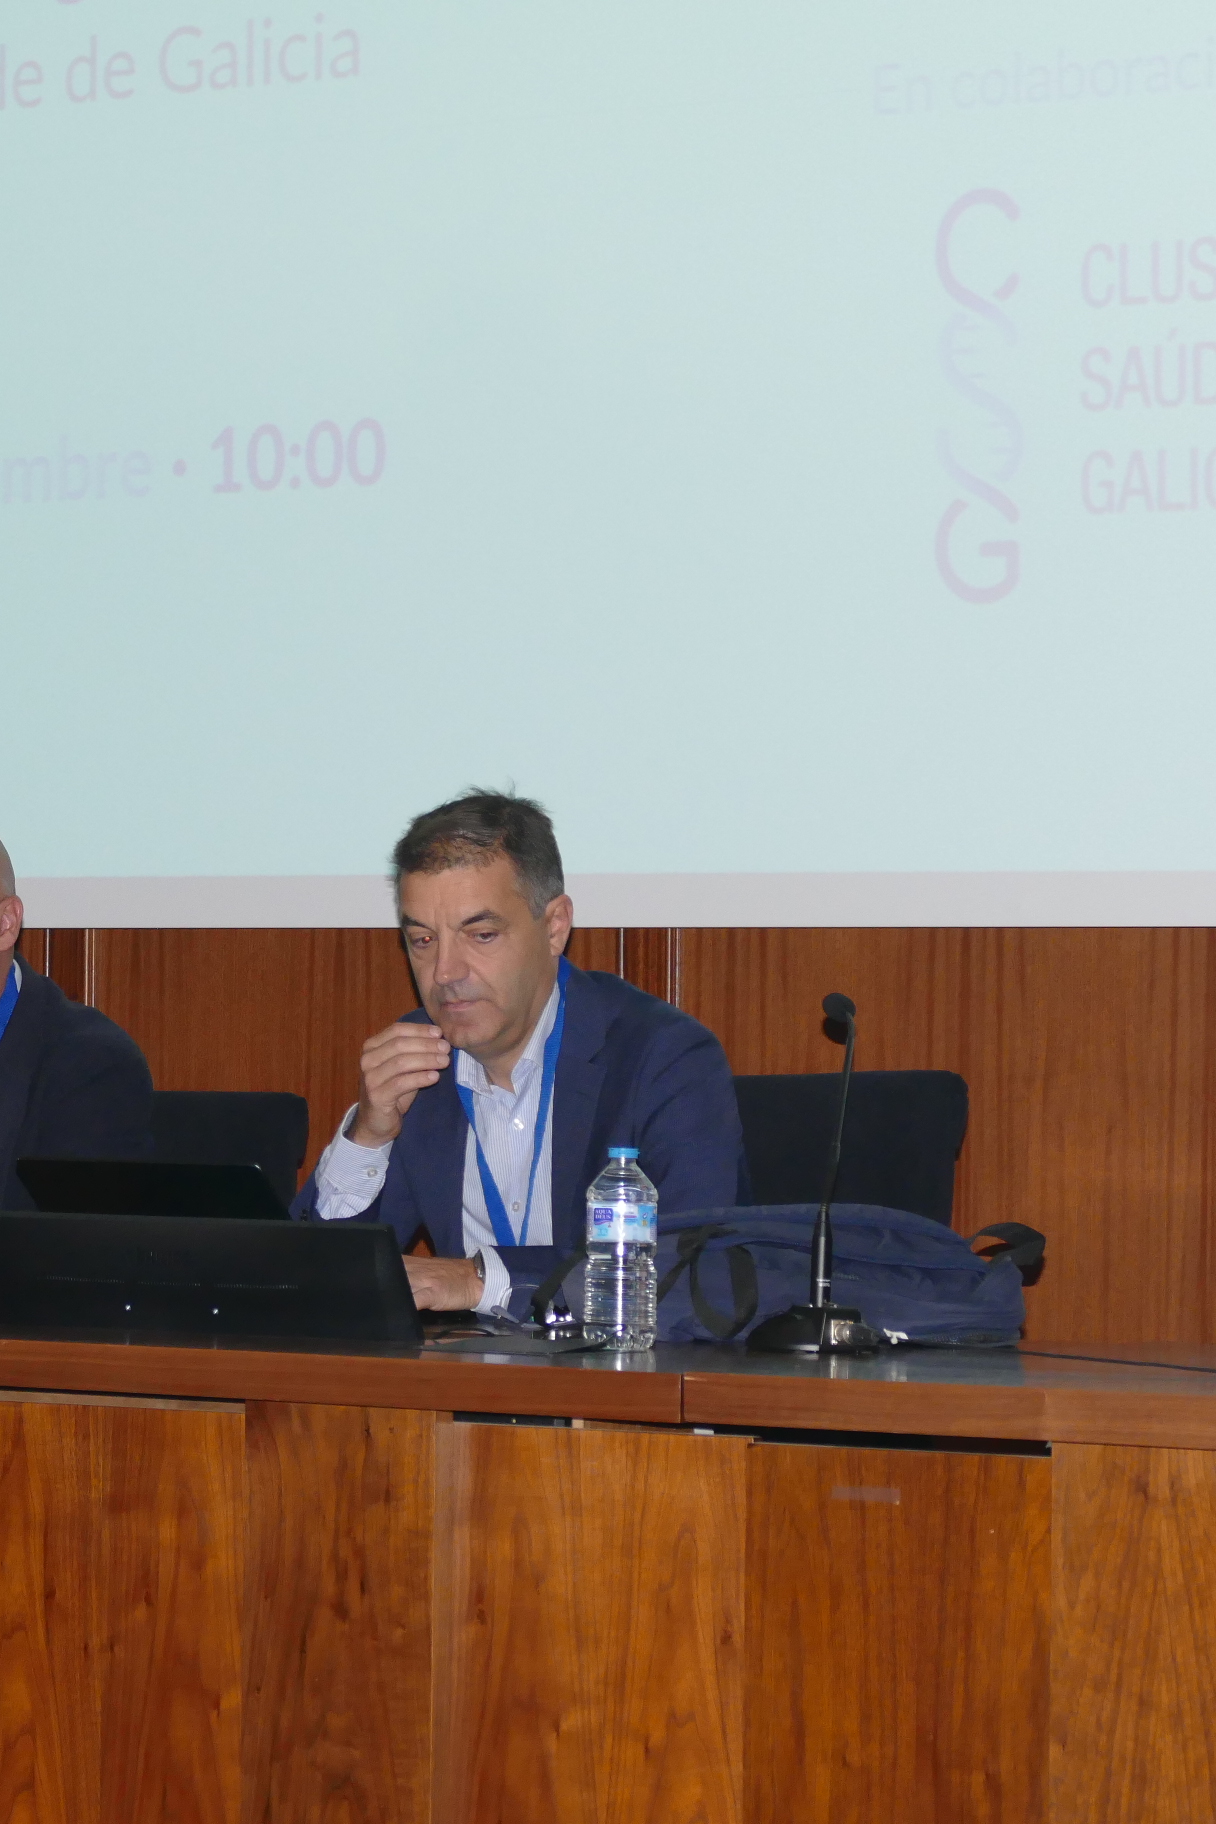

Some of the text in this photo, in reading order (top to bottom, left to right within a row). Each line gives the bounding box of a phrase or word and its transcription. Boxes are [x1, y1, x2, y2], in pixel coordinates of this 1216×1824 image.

[65, 33, 135, 104] de
[158, 11, 360, 94] Galicia
[873, 62, 933, 116] En
[210, 417, 386, 494] 10:00
